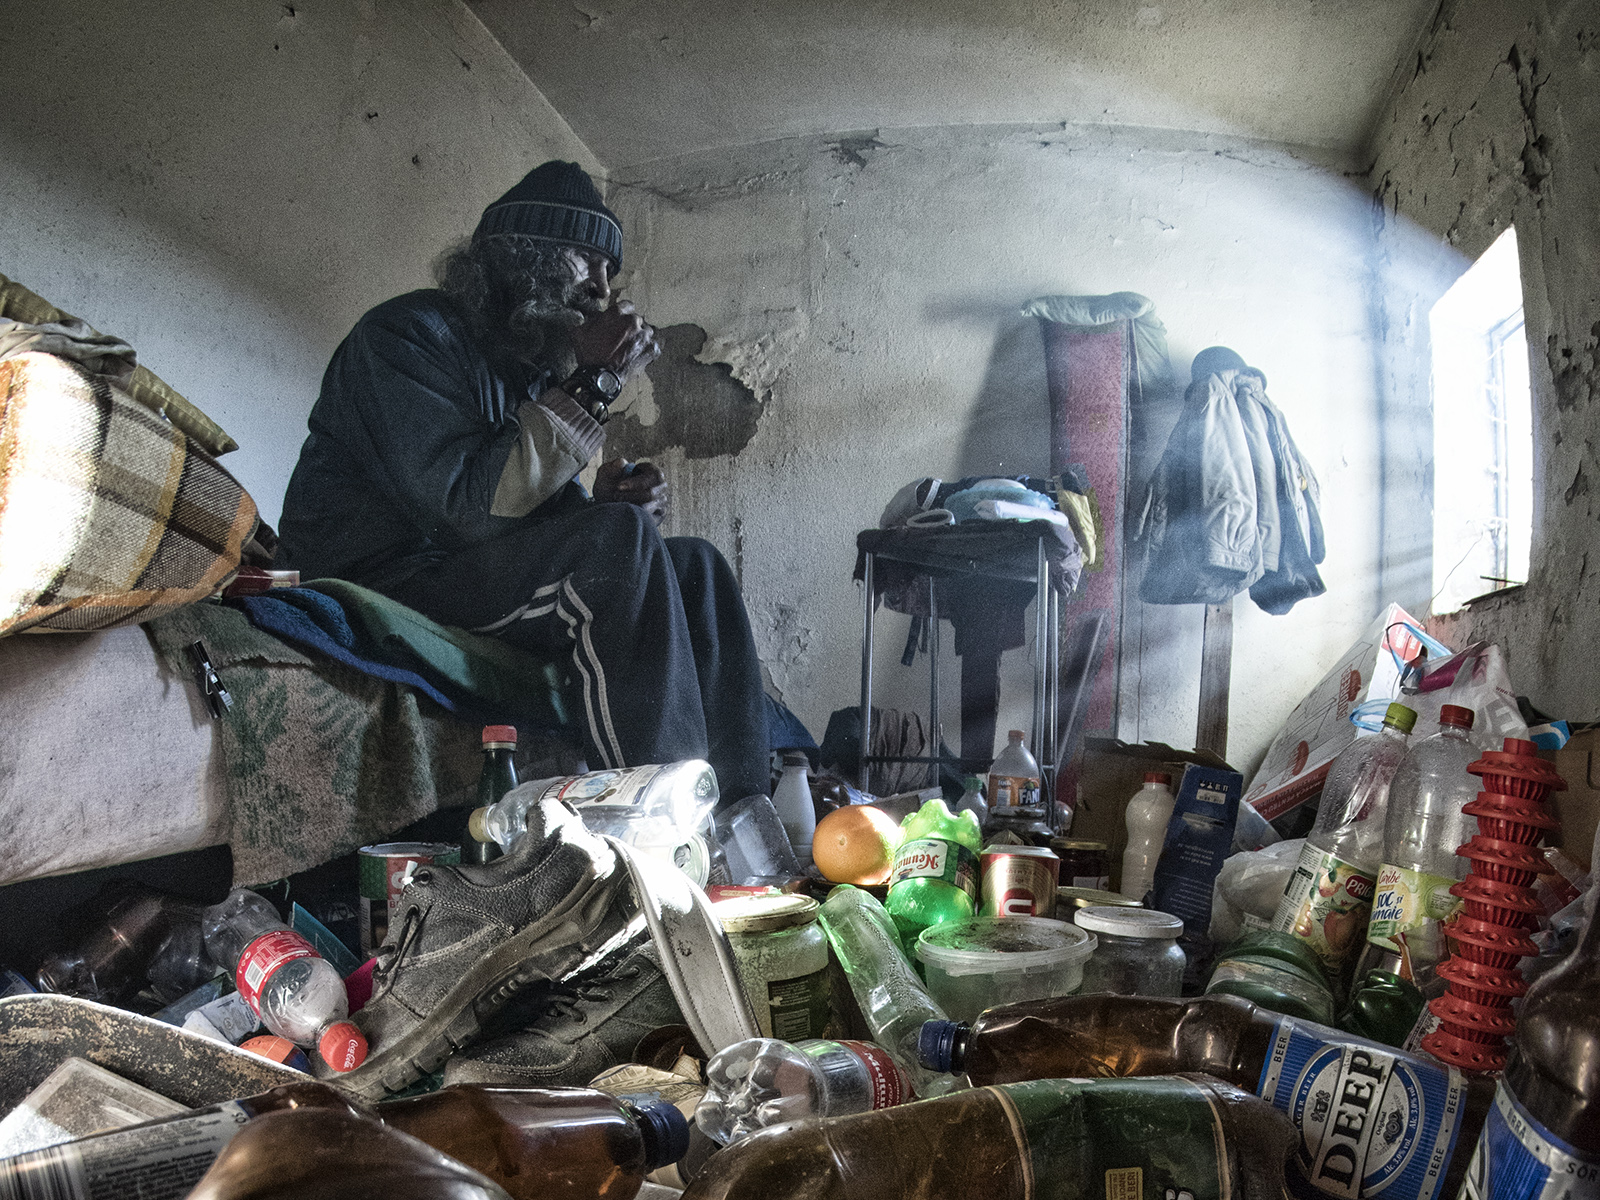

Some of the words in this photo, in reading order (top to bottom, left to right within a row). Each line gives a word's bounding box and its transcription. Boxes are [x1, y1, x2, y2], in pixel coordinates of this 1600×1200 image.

[1020, 790, 1040, 804] FAN
[1348, 879, 1375, 896] PRIG
[1274, 1036, 1288, 1062] BEER
[1302, 1072, 1316, 1096] BEER
[1318, 1050, 1385, 1190] DEEP
[1376, 1112, 1388, 1136] Original
[1428, 1148, 1444, 1178] BERE
[1446, 1088, 1459, 1114] BEER
[1566, 1157, 1598, 1182] SÖR
